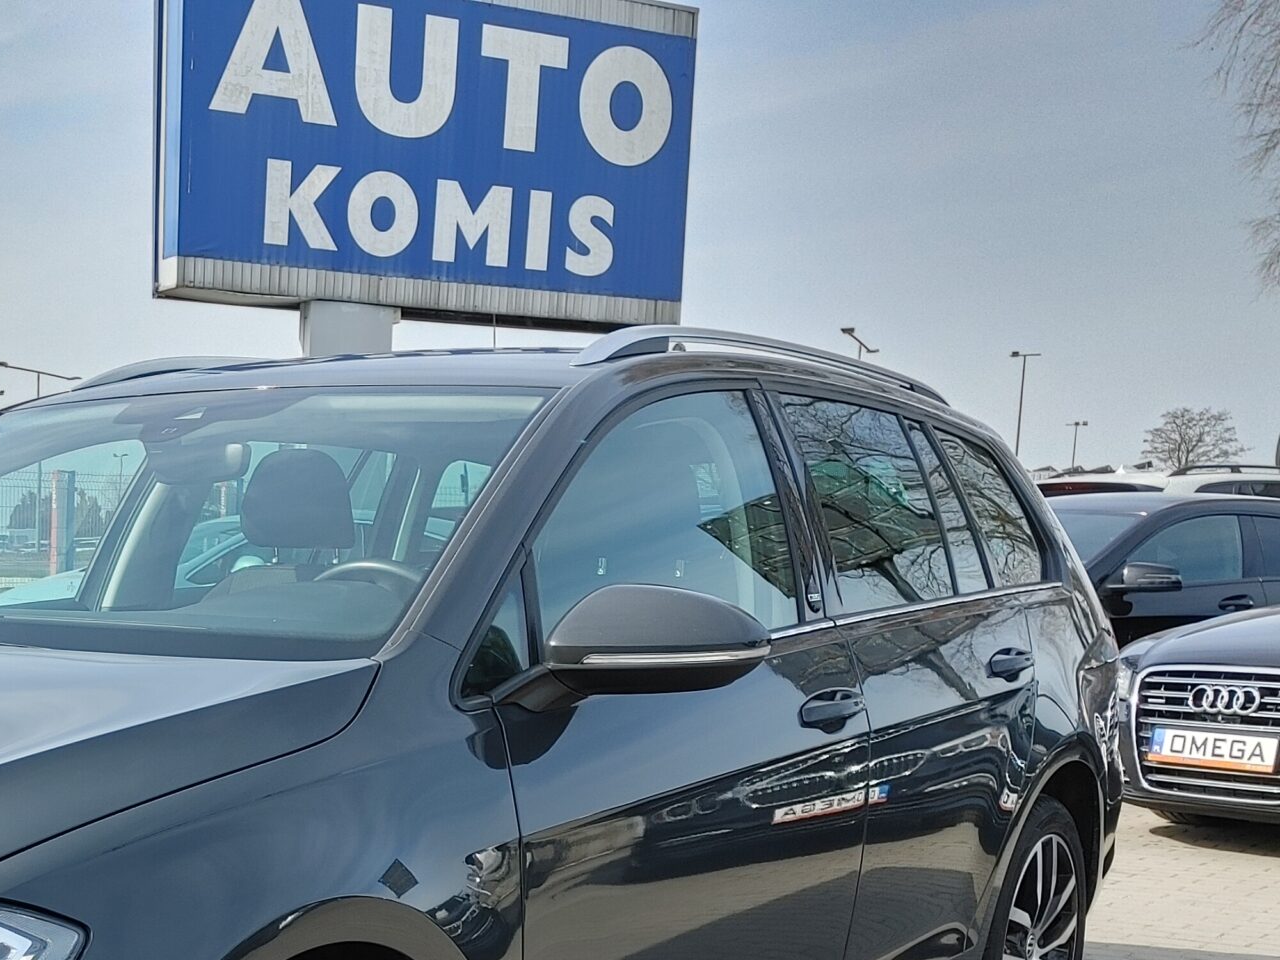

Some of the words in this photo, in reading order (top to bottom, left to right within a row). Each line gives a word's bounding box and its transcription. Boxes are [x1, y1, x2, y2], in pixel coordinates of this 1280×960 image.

[208, 0, 672, 167] AUTO
[263, 158, 615, 276] KOMIS
[1170, 734, 1265, 762] OMEGA
